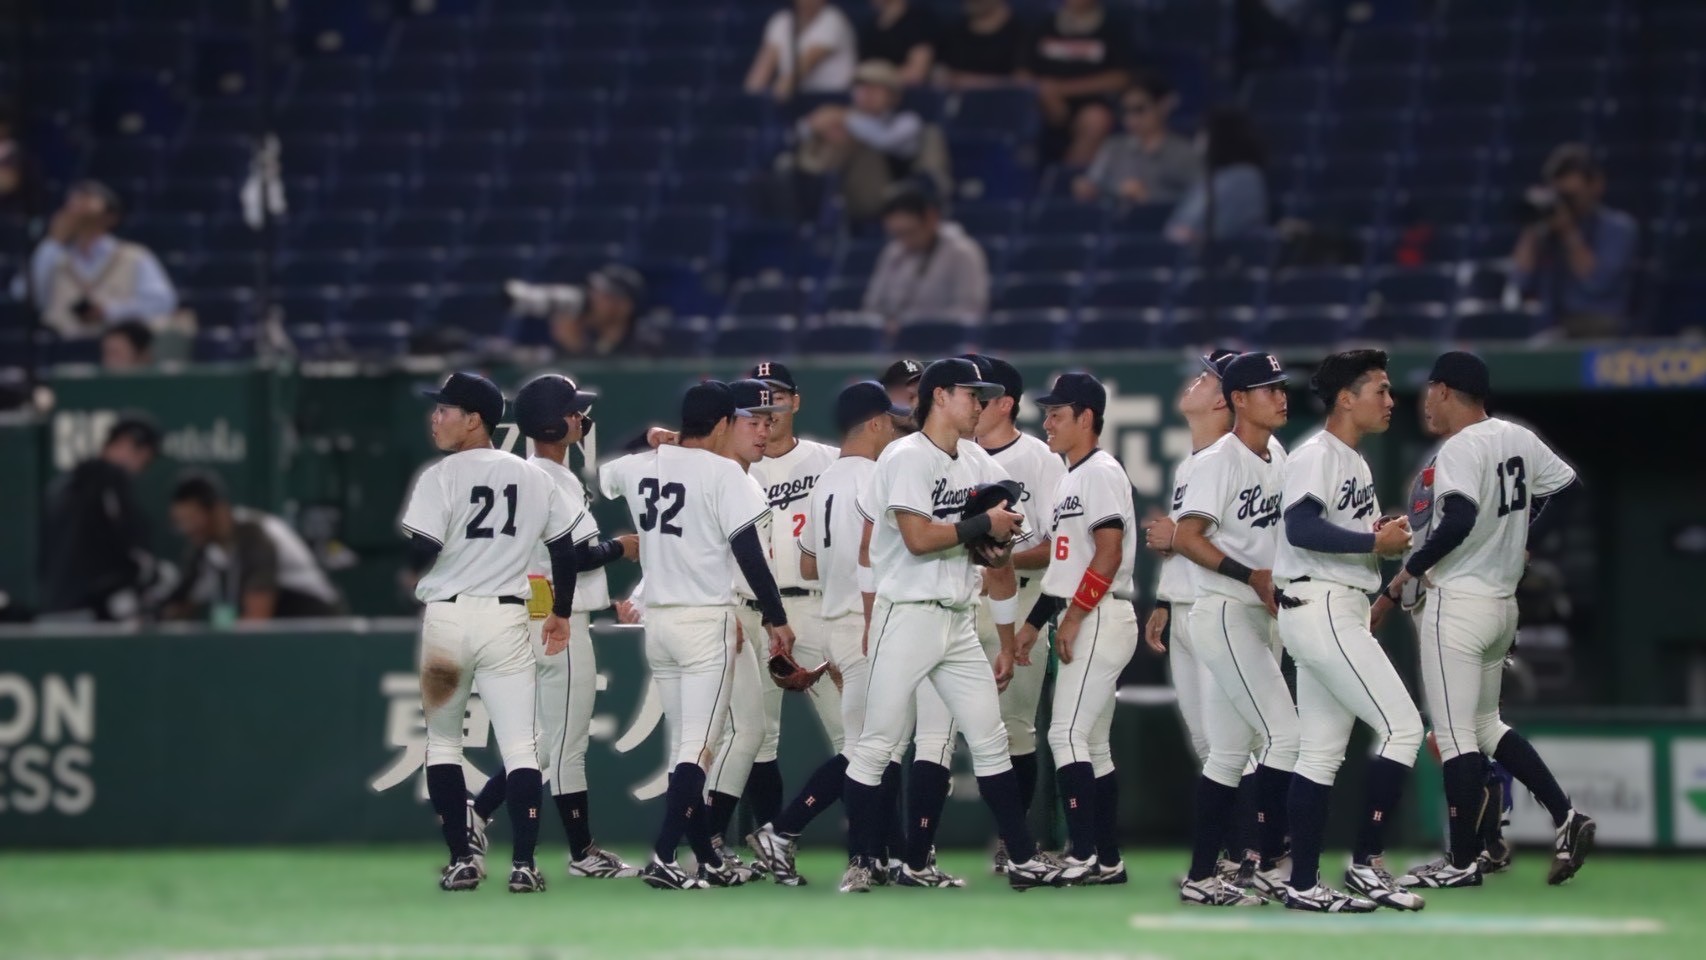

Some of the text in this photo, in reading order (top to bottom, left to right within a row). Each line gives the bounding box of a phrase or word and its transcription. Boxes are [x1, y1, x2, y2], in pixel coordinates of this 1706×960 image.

[758, 362, 771, 377] H
[903, 360, 918, 373] LA
[1266, 355, 1281, 371] H
[760, 390, 770, 407] H
[1497, 456, 1527, 517] 13
[465, 484, 518, 539] 21
[638, 477, 686, 538] 32
[792, 513, 806, 537] 2
[824, 494, 834, 548] 1
[1055, 536, 1069, 561] 6
[0, 672, 95, 743] ON
[0, 745, 95, 814] SS
[528, 808, 537, 818] H
[921, 818, 928, 827] H
[1373, 811, 1382, 821] H
